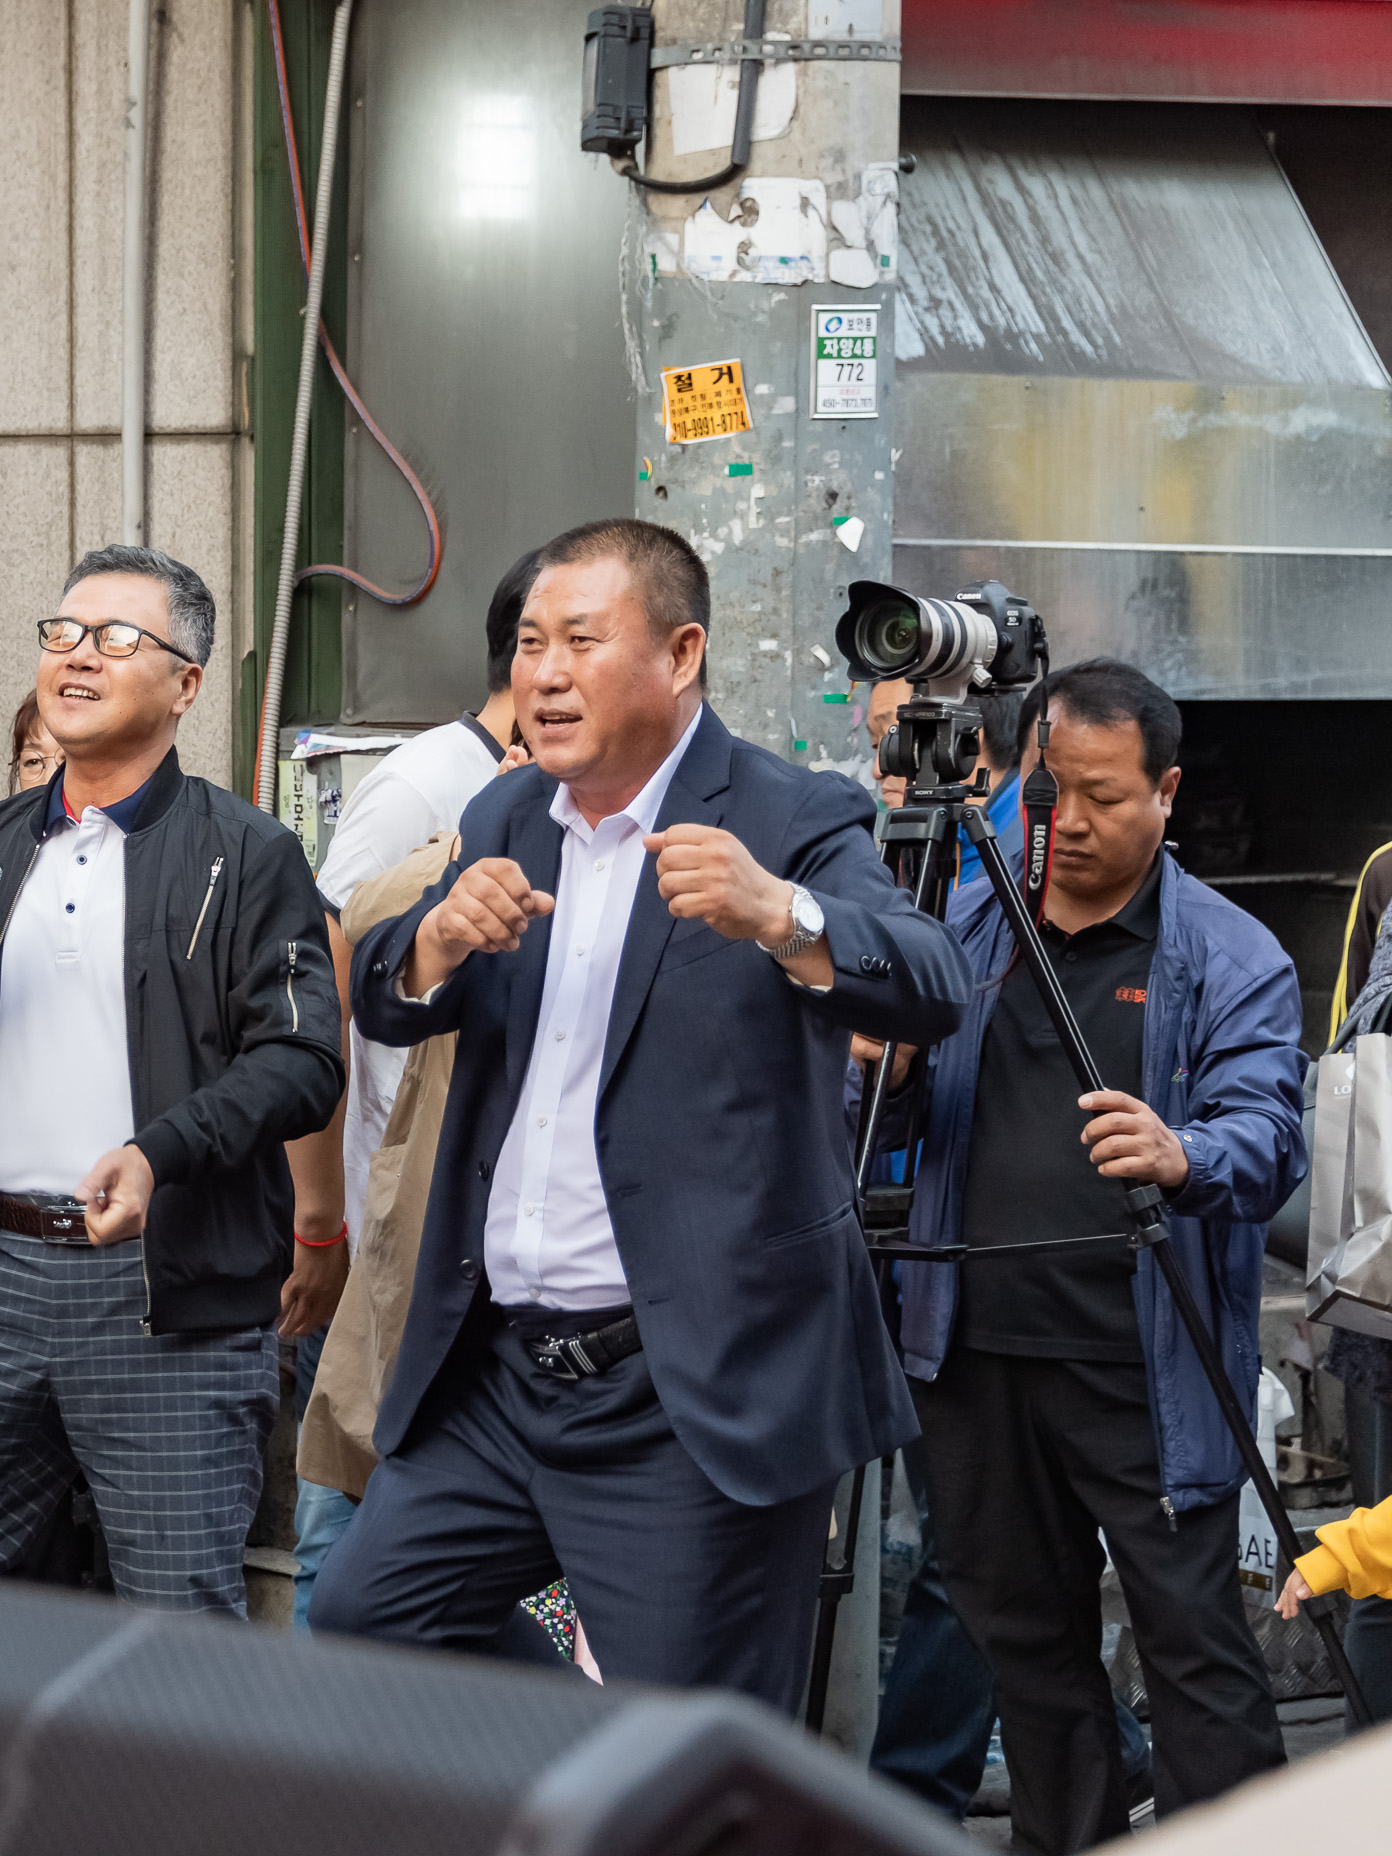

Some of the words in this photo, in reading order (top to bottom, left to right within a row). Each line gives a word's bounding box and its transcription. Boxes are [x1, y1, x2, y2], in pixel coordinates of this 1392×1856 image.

[823, 338, 874, 357] 자양4동
[836, 363, 864, 382] 772
[956, 592, 982, 600] Canon
[1029, 824, 1046, 890] Canon
